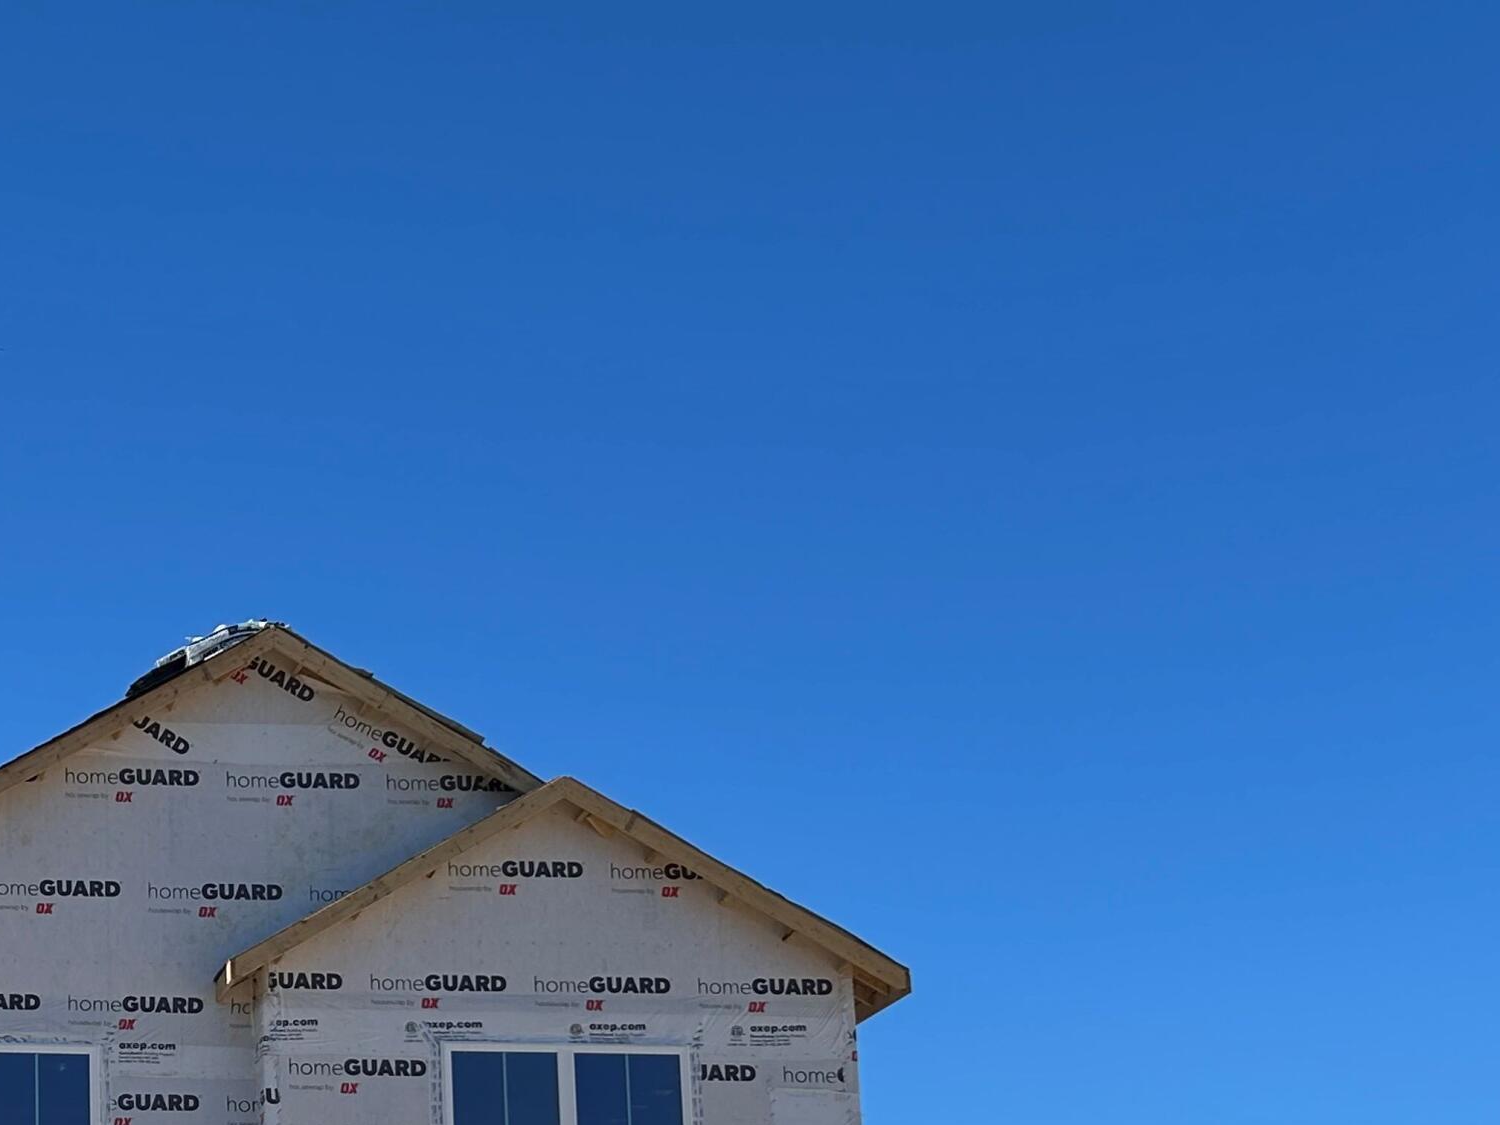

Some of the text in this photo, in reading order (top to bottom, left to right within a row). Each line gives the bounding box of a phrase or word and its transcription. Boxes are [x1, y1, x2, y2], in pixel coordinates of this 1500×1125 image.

[368, 748, 386, 762] OX
[64, 768, 200, 787] homeGUARD
[226, 771, 359, 789] homeGUARD
[115, 791, 133, 802] OX
[276, 795, 293, 806] OX
[436, 798, 454, 808] OX
[448, 861, 583, 878] homeGUARD
[148, 882, 282, 901] homeGUARD
[500, 885, 516, 895] OX
[661, 887, 679, 897] OX
[35, 903, 53, 914] OX
[198, 906, 216, 917] OX
[370, 974, 506, 993] homeGUARD
[534, 976, 670, 994] homeGUARD
[697, 978, 832, 995] homeGUARD
[67, 995, 203, 1014] homeGUARD
[421, 997, 440, 1009] OX
[585, 1000, 603, 1011] OX
[748, 1002, 765, 1013] OX
[119, 1019, 135, 1030] OX
[589, 1022, 646, 1032] oxep.com
[750, 1024, 806, 1034] oxep.com
[119, 1042, 176, 1052] oxep.com
[289, 1058, 426, 1077] homeGUARD
[340, 1083, 359, 1094] OX
